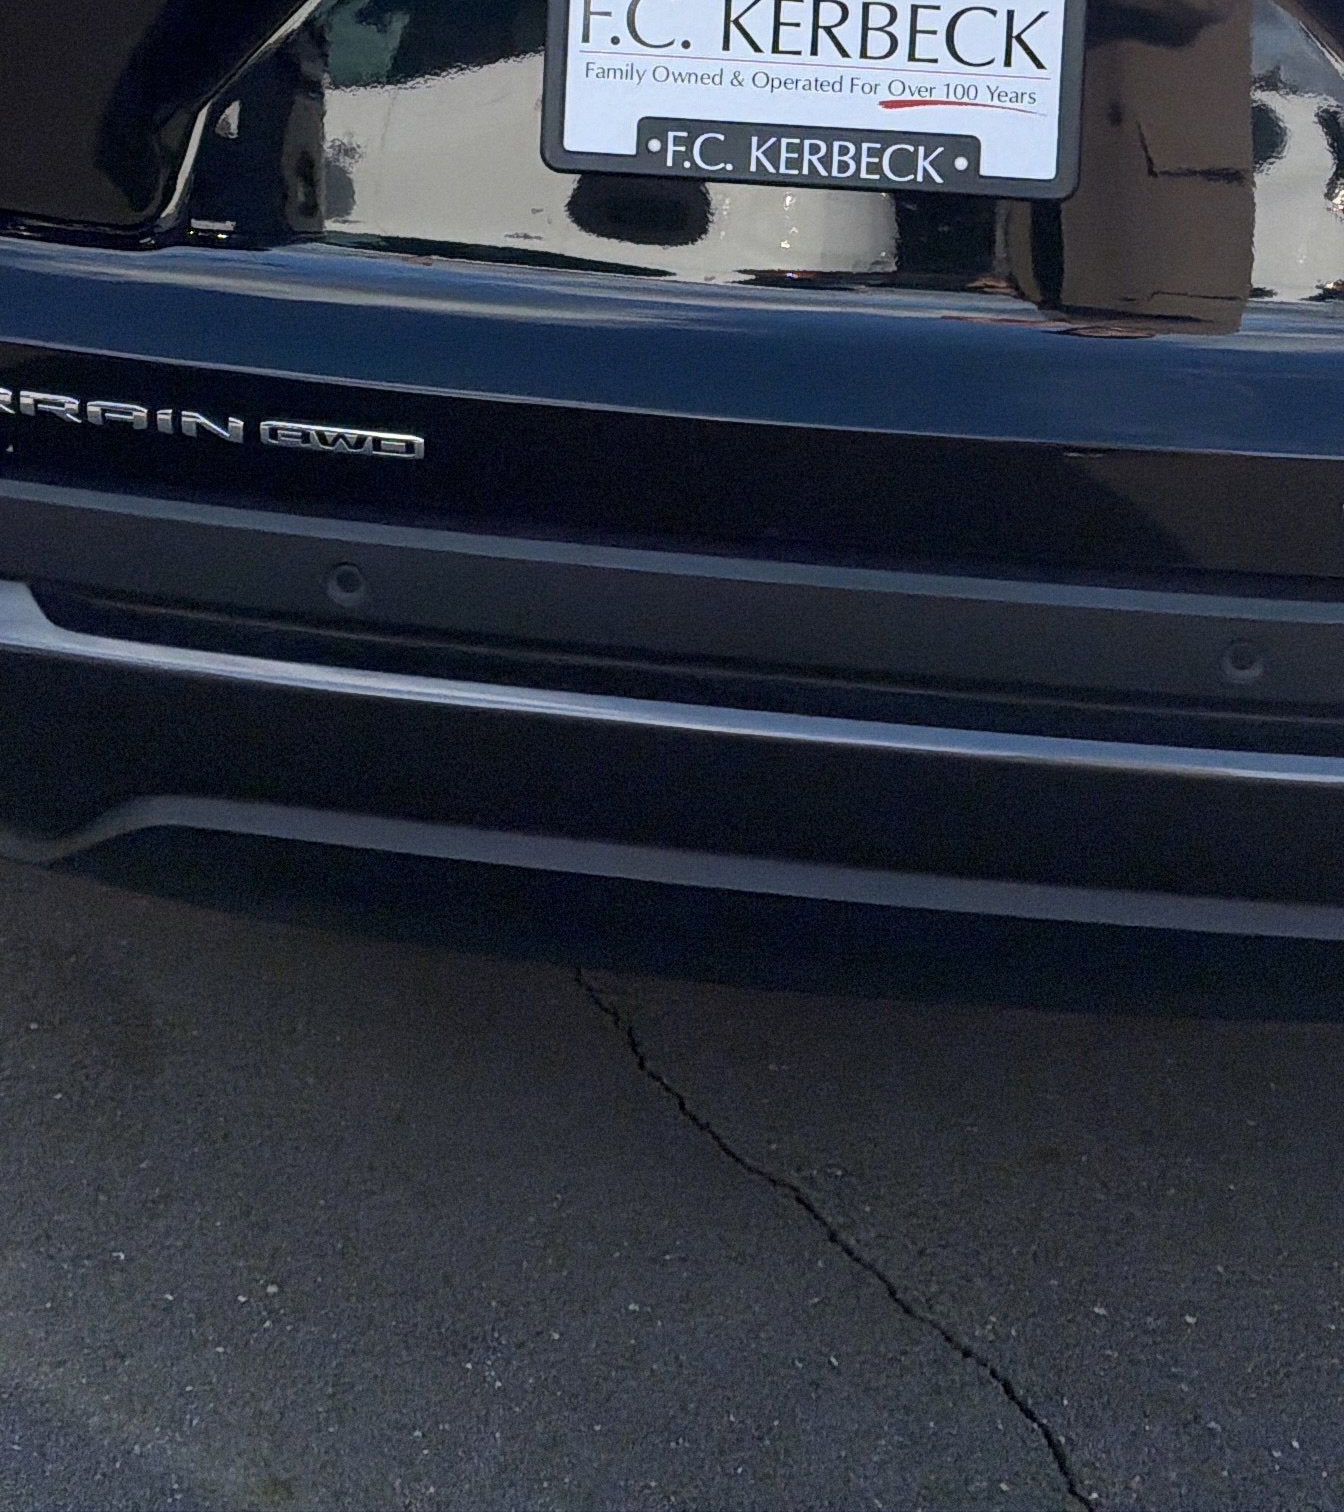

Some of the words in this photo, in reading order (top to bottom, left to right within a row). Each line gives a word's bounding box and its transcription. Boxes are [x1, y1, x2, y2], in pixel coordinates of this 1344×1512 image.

[584, 61, 647, 86] Family
[651, 64, 724, 87] Owned
[729, 70, 746, 88] &
[751, 69, 844, 94] Operated
[849, 76, 882, 95] For
[887, 79, 937, 100] Over
[944, 82, 979, 101] 100
[986, 84, 1038, 105] Years
[665, 130, 734, 172] F.C.
[748, 135, 946, 184] KERBECK
